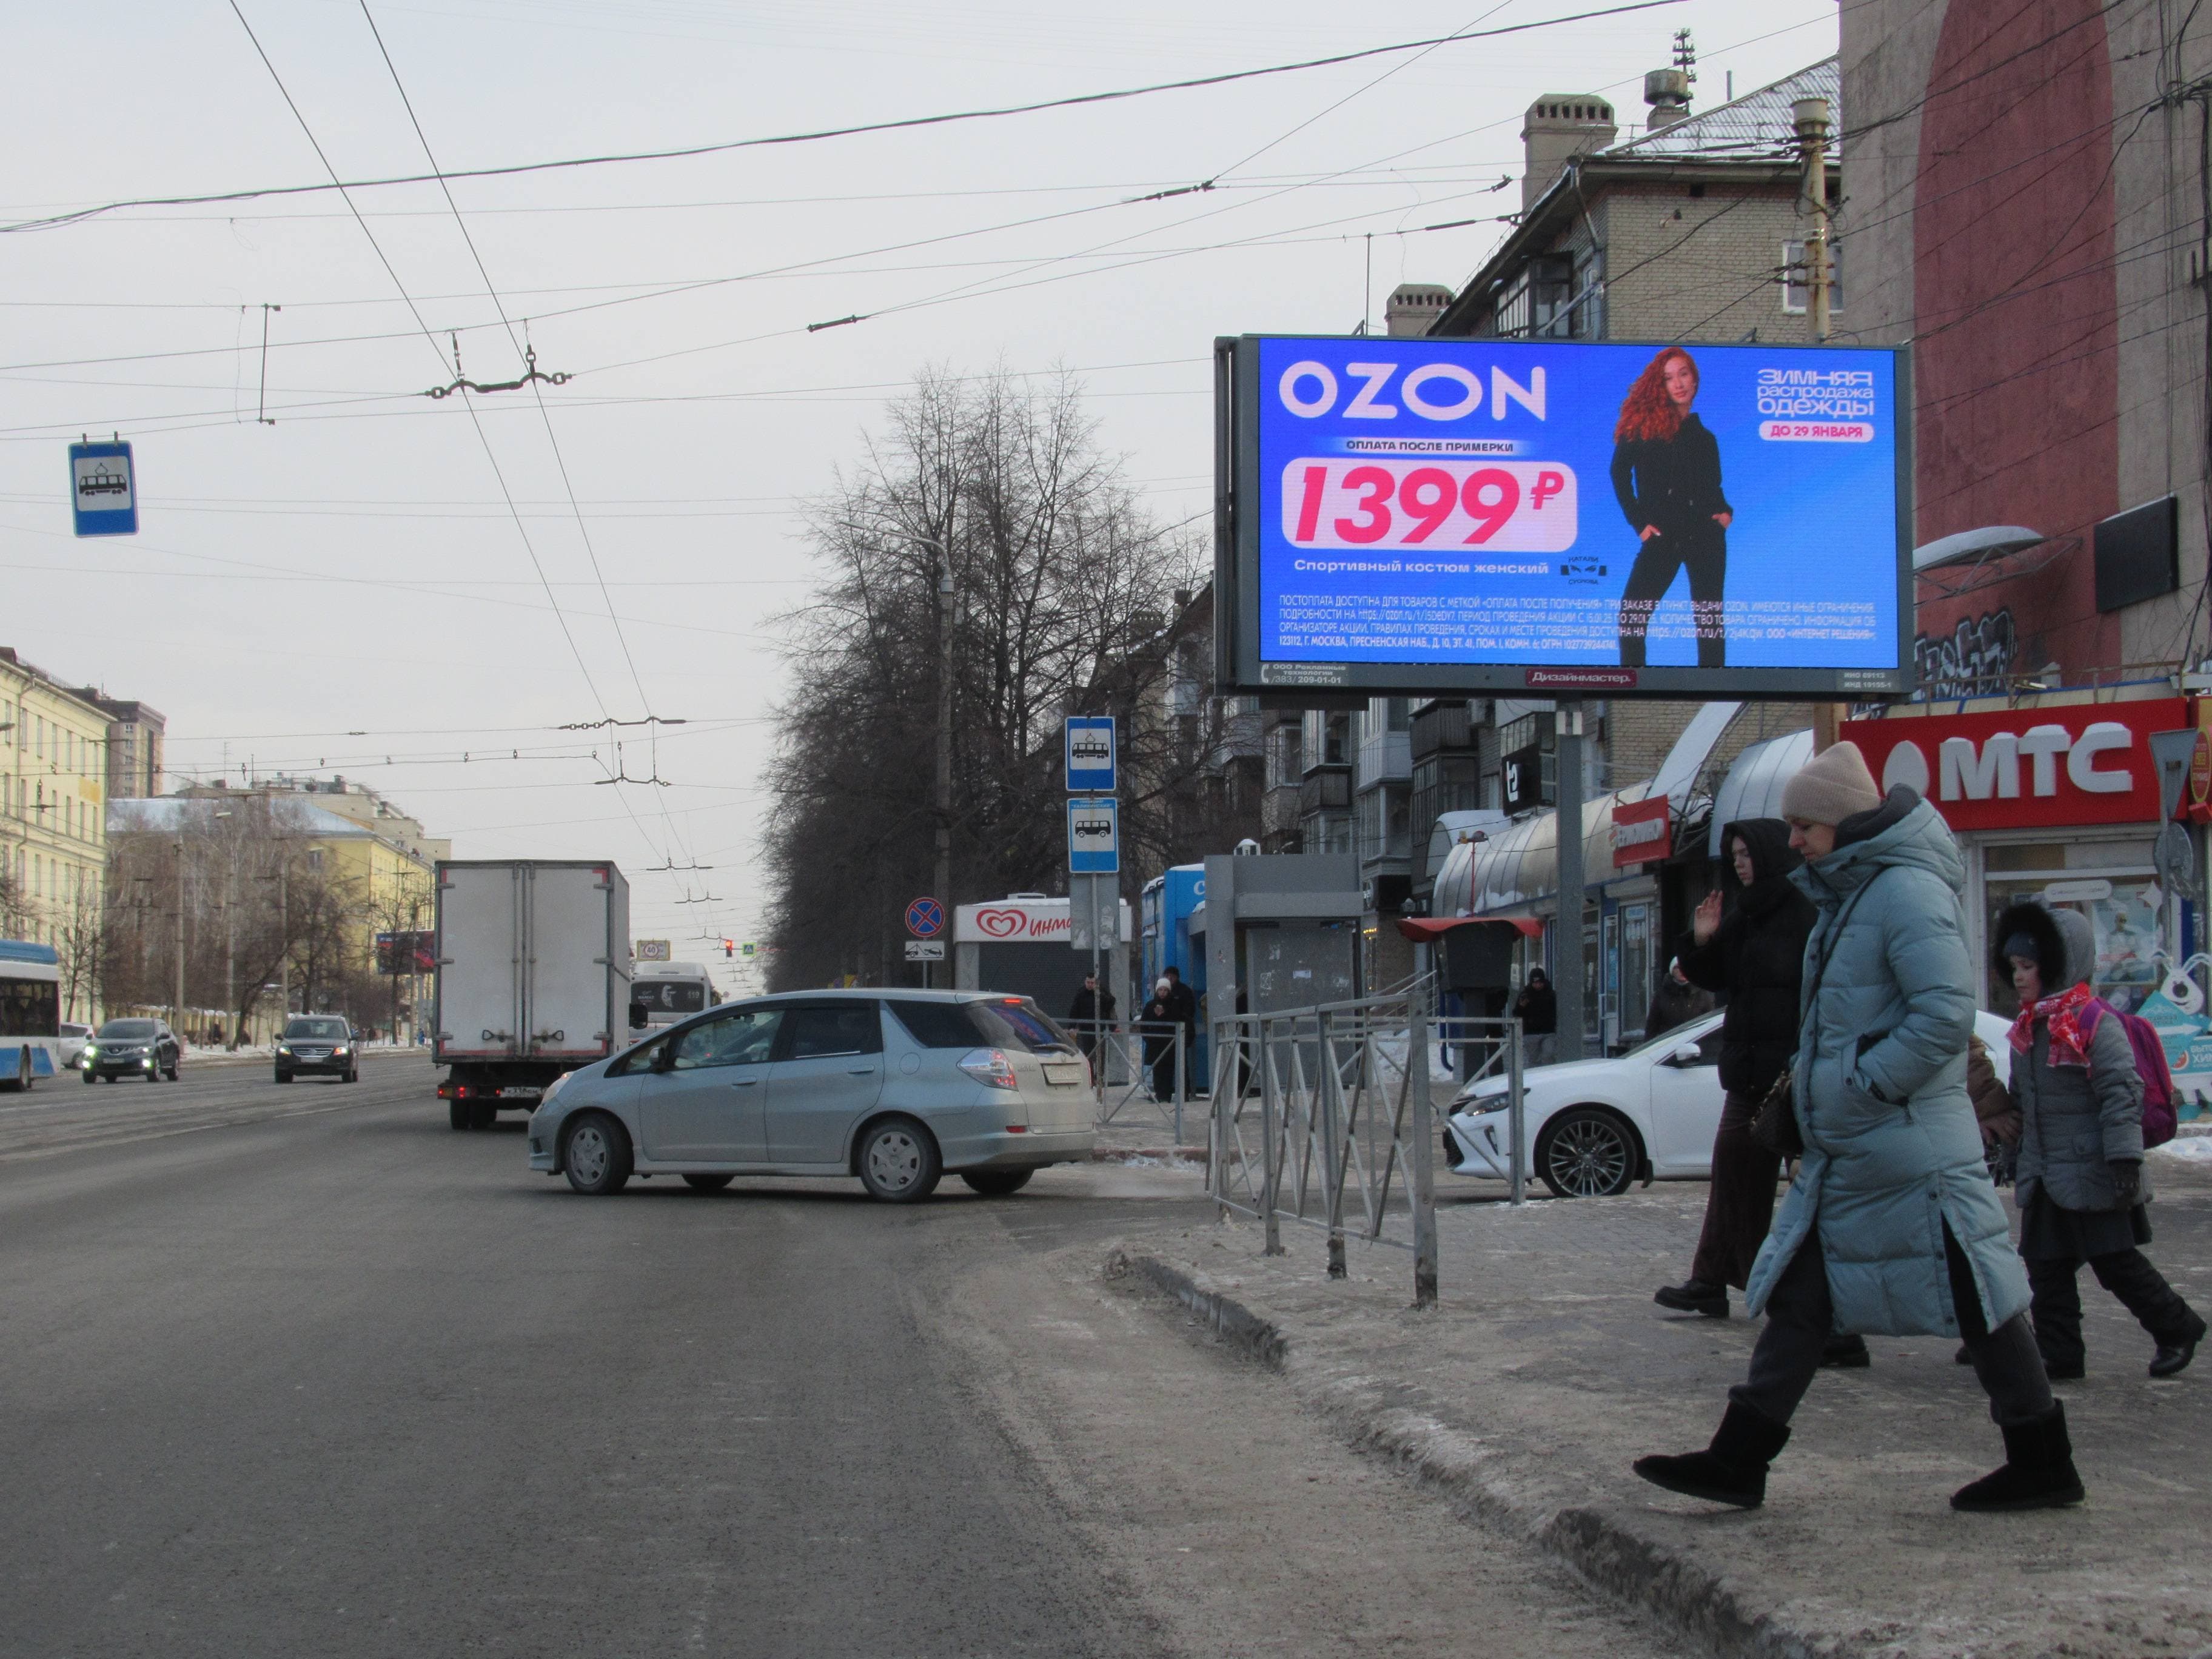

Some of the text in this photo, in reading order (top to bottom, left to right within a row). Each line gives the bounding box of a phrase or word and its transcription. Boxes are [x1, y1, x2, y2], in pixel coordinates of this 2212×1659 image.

[1279, 360, 1546, 421] OZON
[1757, 386, 1874, 400] распродажа
[1771, 426, 1863, 437] ДО 29 ЯНВАРЯ
[1346, 440, 1514, 453] ОПЛАТА ПОСЛЕ ПРИМЕРКИ
[1295, 466, 1521, 545] 1399
[1294, 560, 1549, 574] Спортивный костюм женский
[1279, 595, 1333, 606] ПОСТОПЛАТА
[1335, 595, 1380, 607] ДОСТУПНА
[1382, 596, 1398, 607] ДЛЯ
[1400, 596, 1438, 607] ТОВАРОВ
[1439, 597, 1446, 608] С
[1447, 596, 1480, 608] МЕТКОЙ
[1520, 598, 1547, 609] ПОСЛЕ
[1623, 599, 1653, 611] ЗАКАЗЕ
[1655, 600, 1661, 611] В
[1691, 600, 1723, 612] ВЫДАЧИ
[1279, 608, 1341, 619] ПОДРОБНОСТИ
[1344, 609, 1356, 619] НА
[1458, 611, 1490, 622] ПЕРИОД
[1492, 611, 1546, 623] ПРОВЕДЕНИЯ
[1547, 612, 1576, 623] АКЦИИ
[1578, 612, 1584, 623] С
[1614, 613, 1627, 624] ПО
[1660, 613, 1713, 625] КОЛИЧЕСТВО
[1279, 622, 1338, 632] ОРГАНИЗАТОРЕ
[1370, 623, 1412, 634] ПРАВИЛАХ
[1468, 625, 1500, 635] СРОКАХ
[1503, 625, 1509, 635] И
[1510, 625, 1534, 635] МЕСТЕ
[1536, 625, 1587, 637] ПРОВЕДЕНИЯ
[1634, 627, 1644, 637] НА
[1766, 628, 1786, 638] ООО
[1279, 635, 1302, 647] 123112,
[1311, 635, 1348, 648] МОСКВА,
[1350, 636, 1409, 648] ПРЕСНЕНСКАЯ
[1939, 723, 2133, 801] МТС
